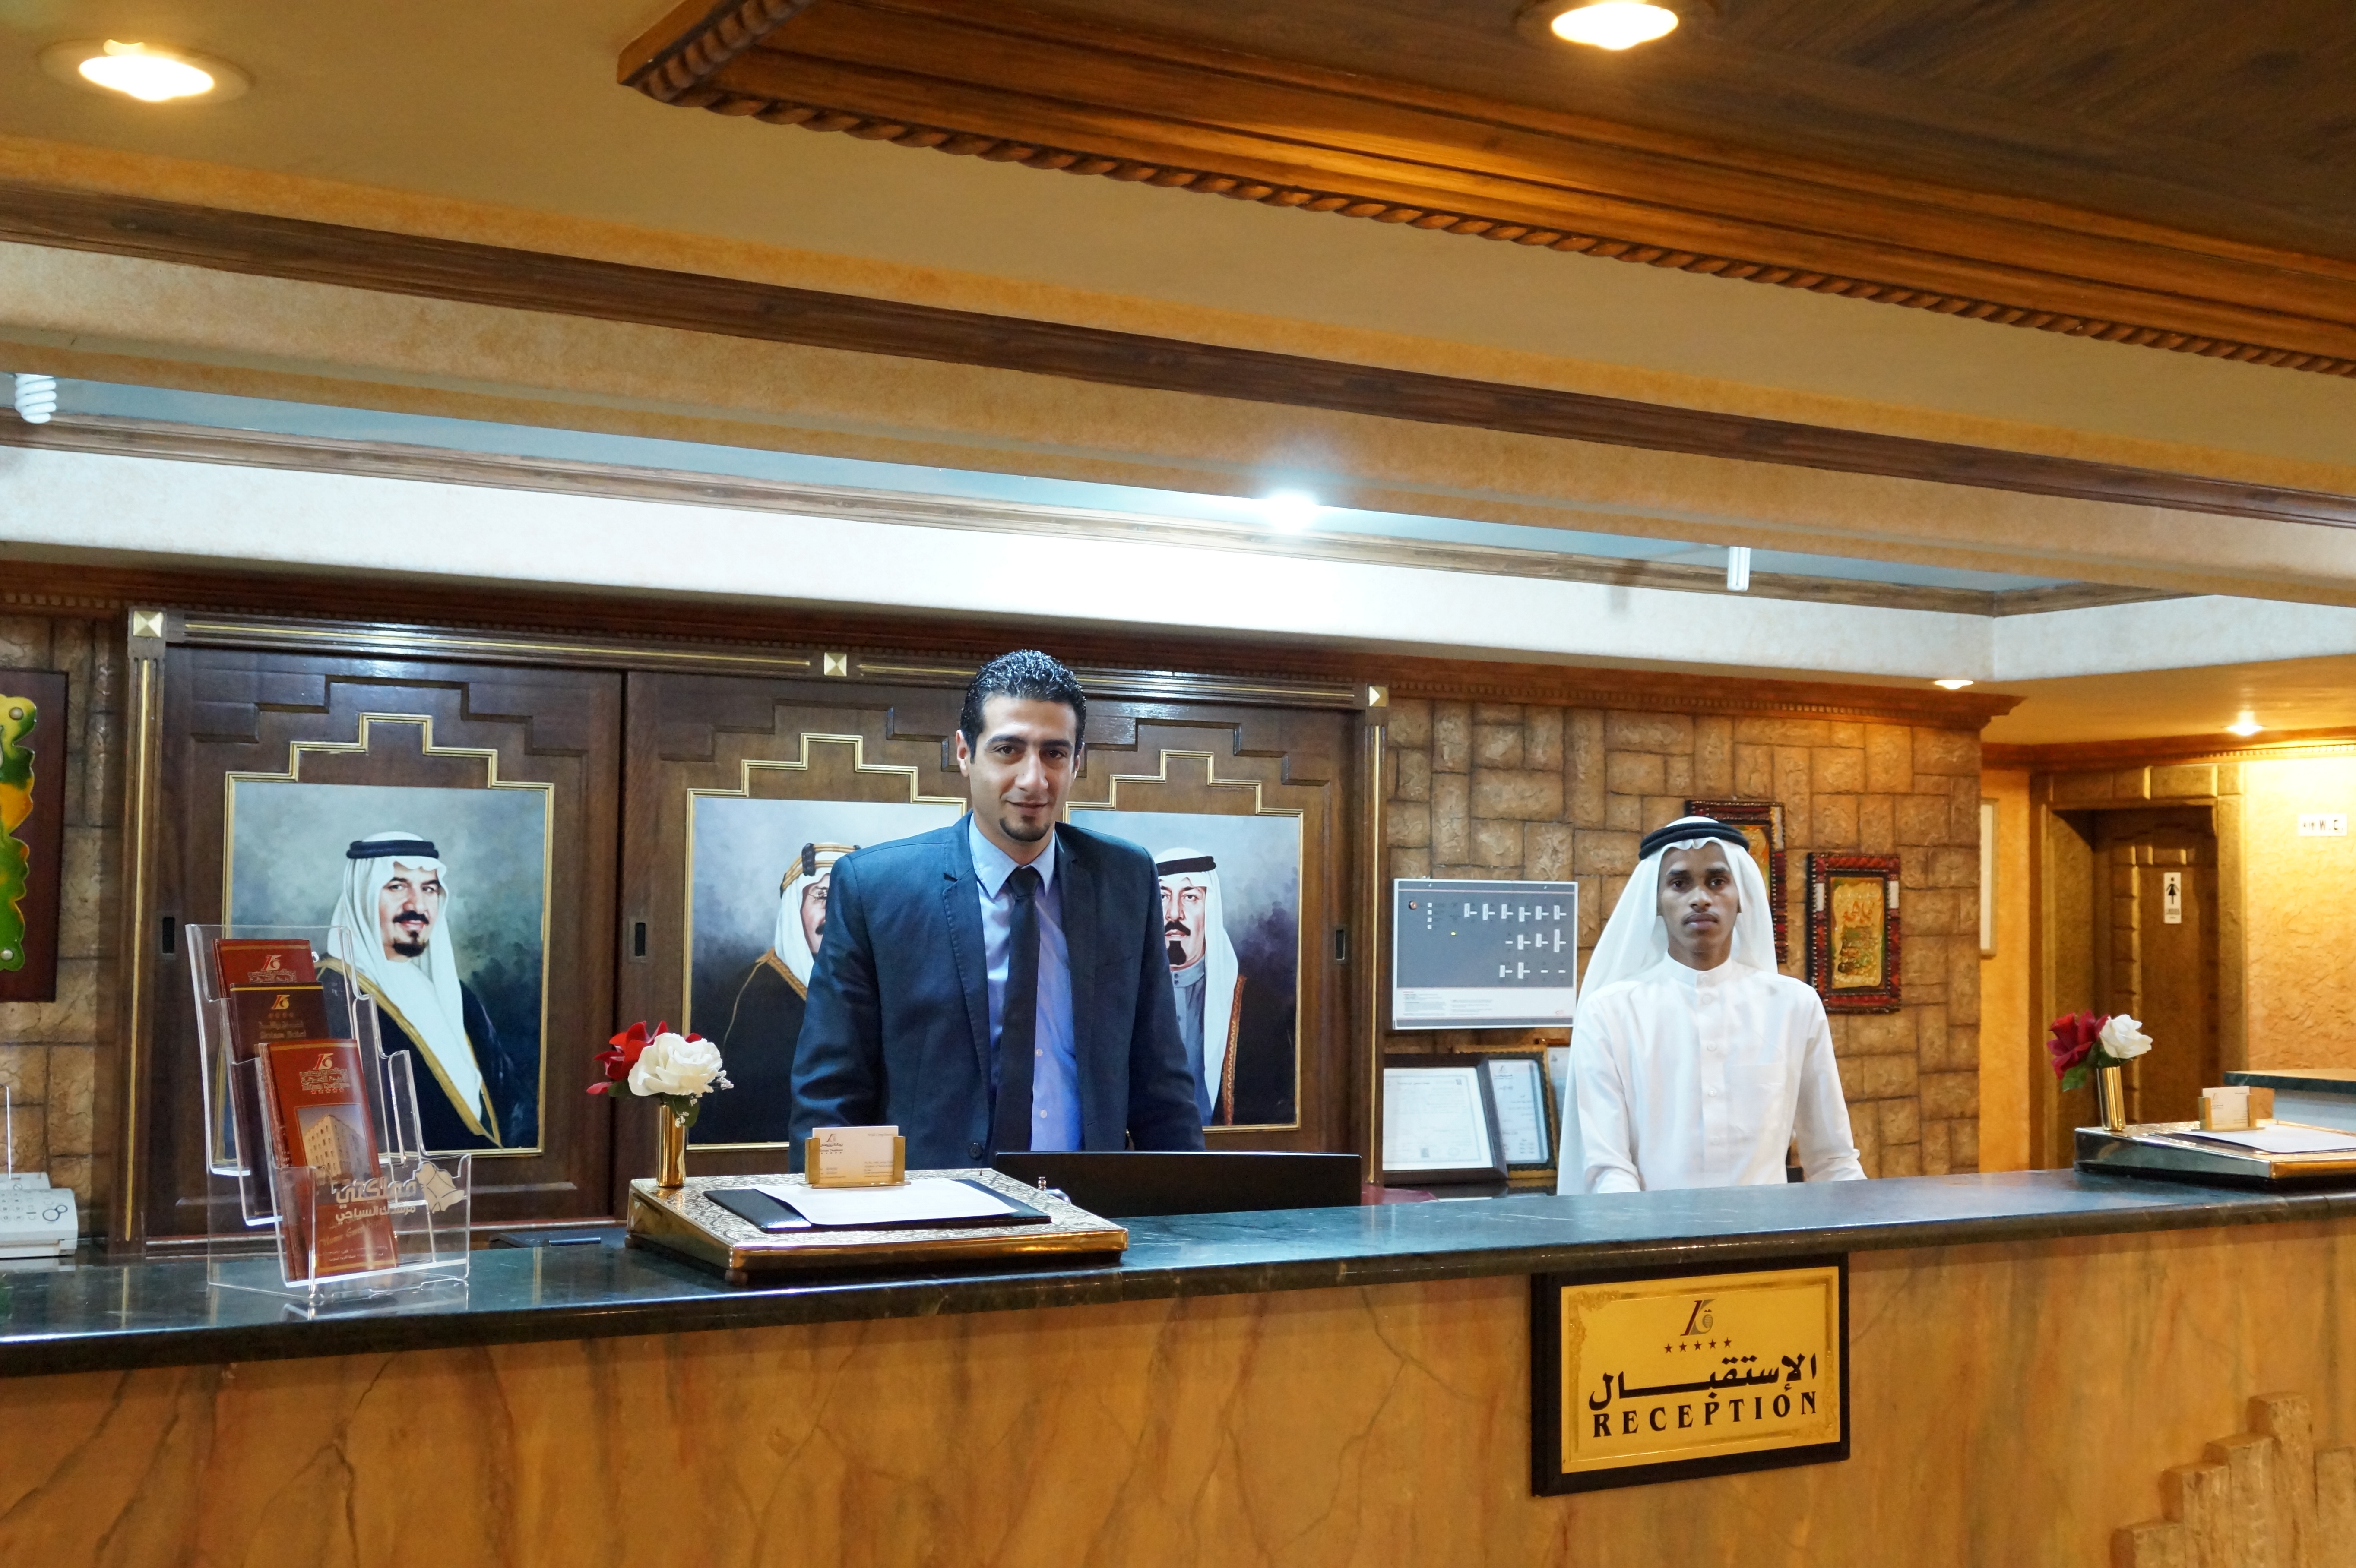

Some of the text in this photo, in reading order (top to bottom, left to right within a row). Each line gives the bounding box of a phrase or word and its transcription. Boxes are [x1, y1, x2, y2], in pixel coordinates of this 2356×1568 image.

[336, 1177, 417, 1208] مملكتي
[335, 1206, 378, 1225] السياحي
[1593, 1390, 1817, 1438] RECEPTION
